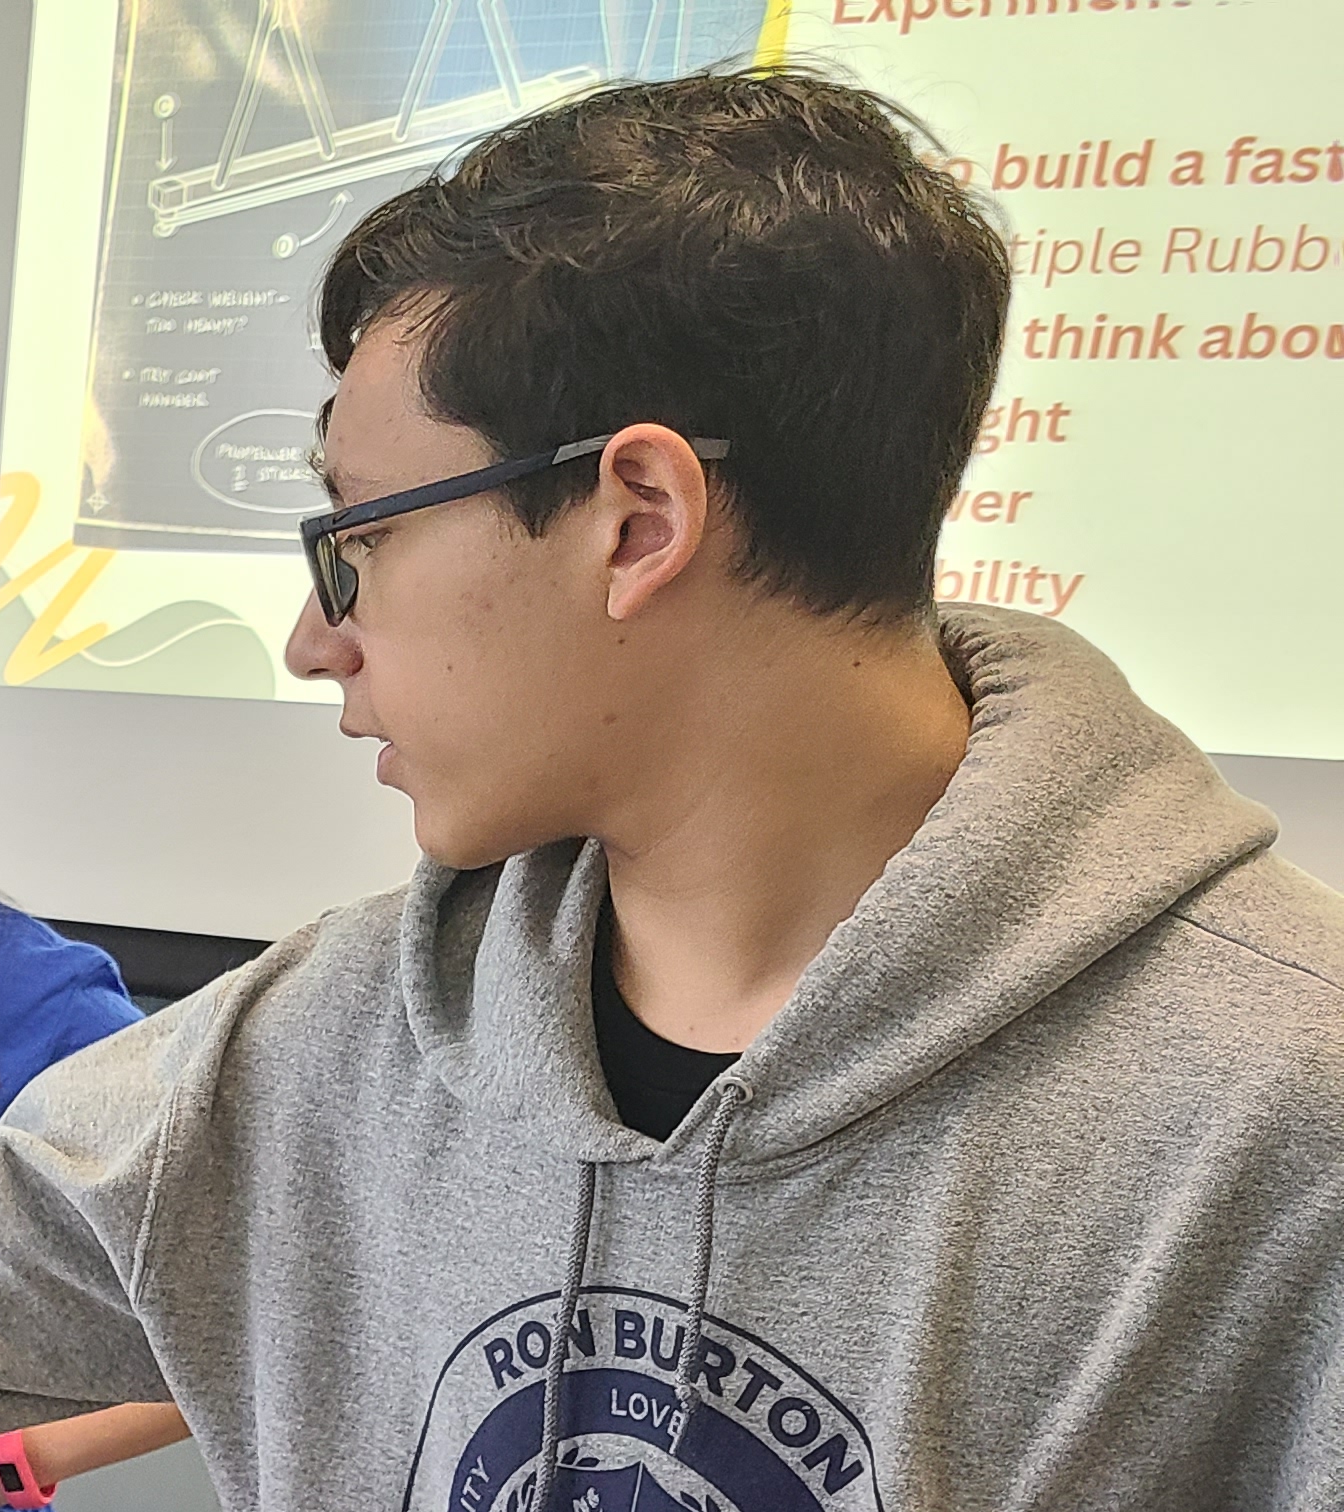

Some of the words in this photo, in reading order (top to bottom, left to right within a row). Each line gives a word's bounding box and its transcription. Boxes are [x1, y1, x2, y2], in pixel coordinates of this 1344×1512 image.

[992, 141, 1155, 191] build
[1170, 146, 1205, 186] a
[1161, 224, 1342, 275] Rubb
[1024, 313, 1182, 361] think
[483, 1308, 597, 1390] RON
[614, 1309, 865, 1496] BURTON
[610, 1388, 688, 1438] LOVE
